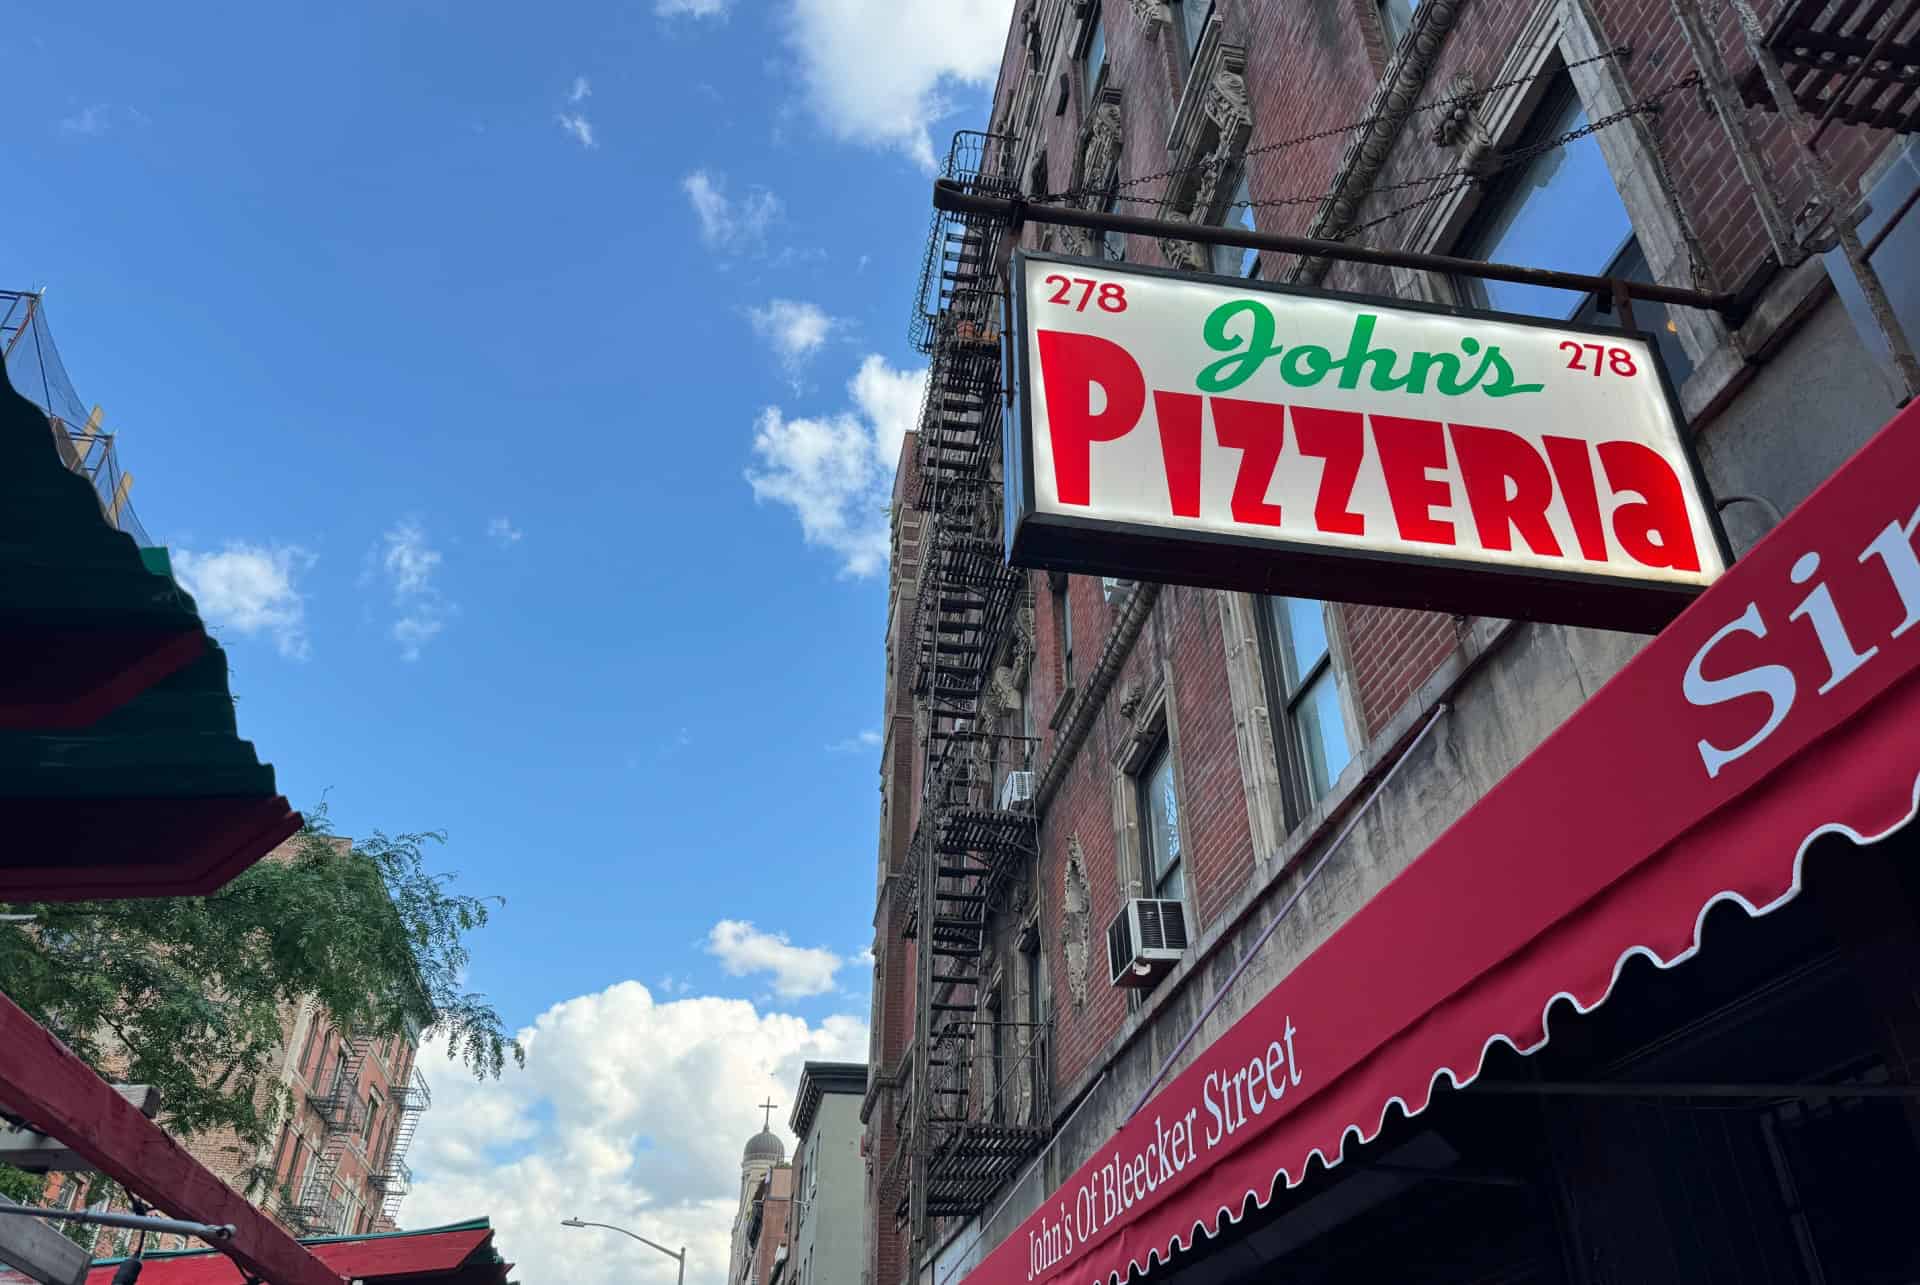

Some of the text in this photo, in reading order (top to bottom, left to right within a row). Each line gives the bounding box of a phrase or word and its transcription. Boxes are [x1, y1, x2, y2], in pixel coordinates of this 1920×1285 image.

[1045, 275, 1128, 313] 278
[1195, 299, 1545, 398] John's
[1559, 341, 1637, 377] 278
[1027, 1015, 1303, 1281] John's Of Bleecker Street
